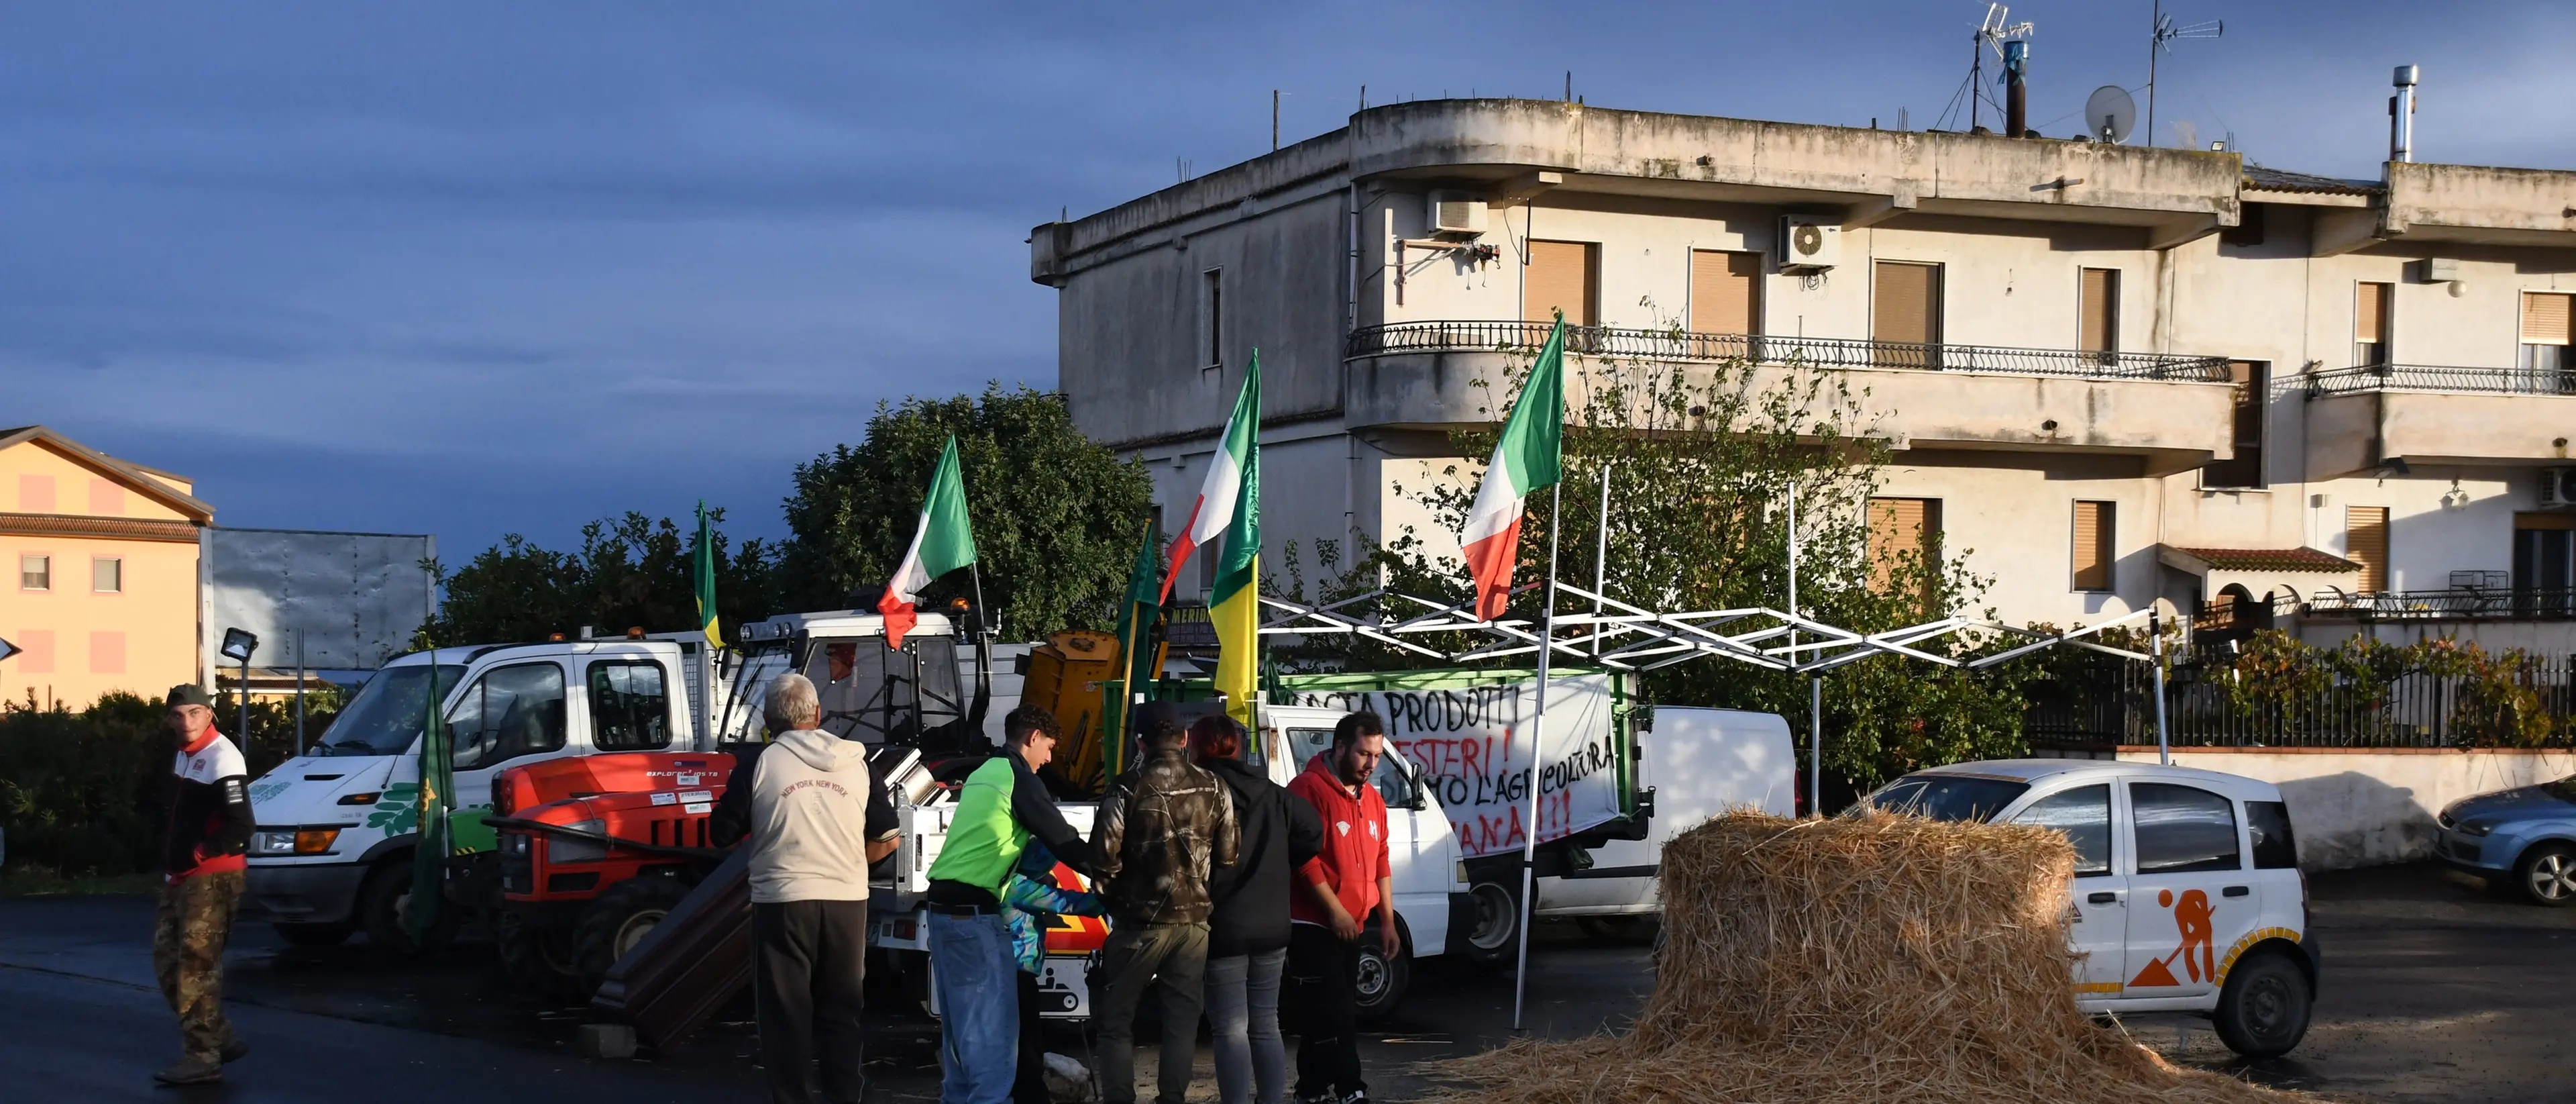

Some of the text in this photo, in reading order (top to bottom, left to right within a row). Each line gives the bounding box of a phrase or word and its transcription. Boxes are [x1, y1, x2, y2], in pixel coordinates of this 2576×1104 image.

[1385, 686, 1520, 736] PRODOTTI
[781, 779, 849, 799] NEW YORK NEW YORK
